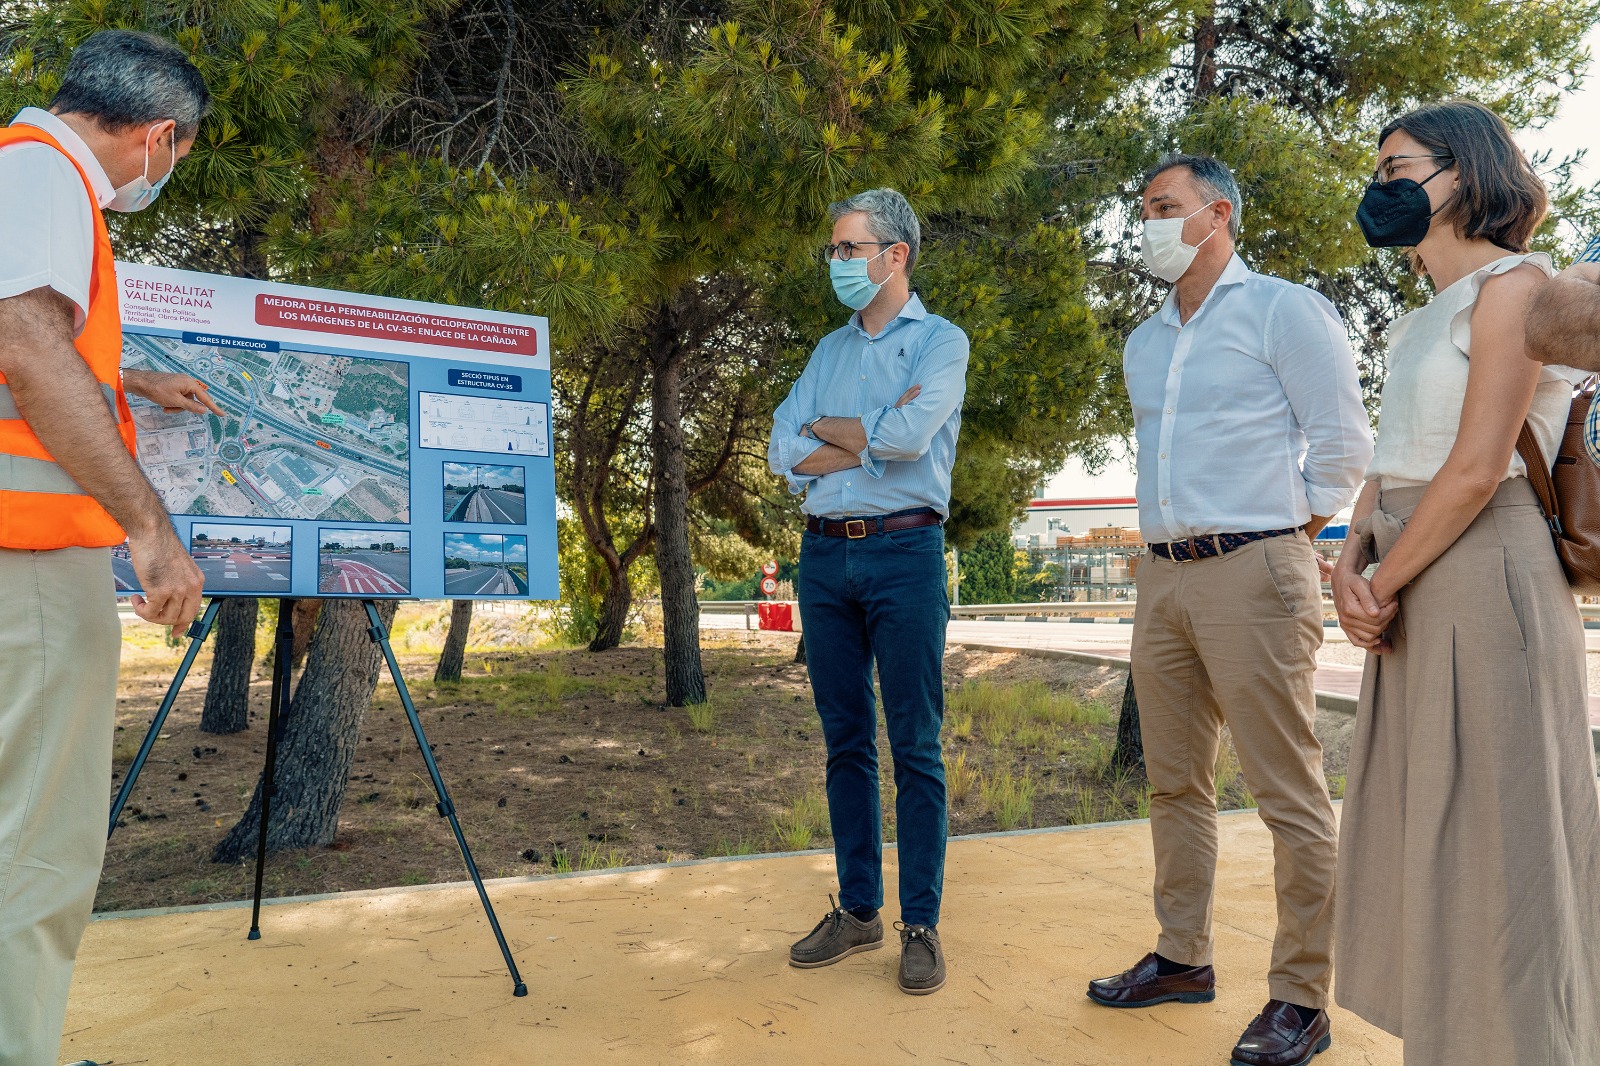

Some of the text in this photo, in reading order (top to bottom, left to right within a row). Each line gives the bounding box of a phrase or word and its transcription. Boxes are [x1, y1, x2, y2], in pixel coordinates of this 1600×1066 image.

[124, 278, 216, 298] GENERALITAT
[124, 290, 213, 309] VALENCIANA
[123, 303, 161, 313] Conselleria
[124, 310, 155, 318] Territorial,
[157, 313, 178, 321] Obres
[127, 316, 156, 324] Mobilitat
[263, 297, 530, 337] MEJORA DE LA PERMEABILIZACIÓN CICLOPEATONAL ENTRE
[279, 311, 518, 346] LOS MÁRGENES DE LA CV-35: ENLACE DE LA CAÑADA
[196, 336, 220, 344] OBRES
[232, 340, 267, 349] EXECUCIÓ
[457, 379, 495, 388] ESTRUCTURA
